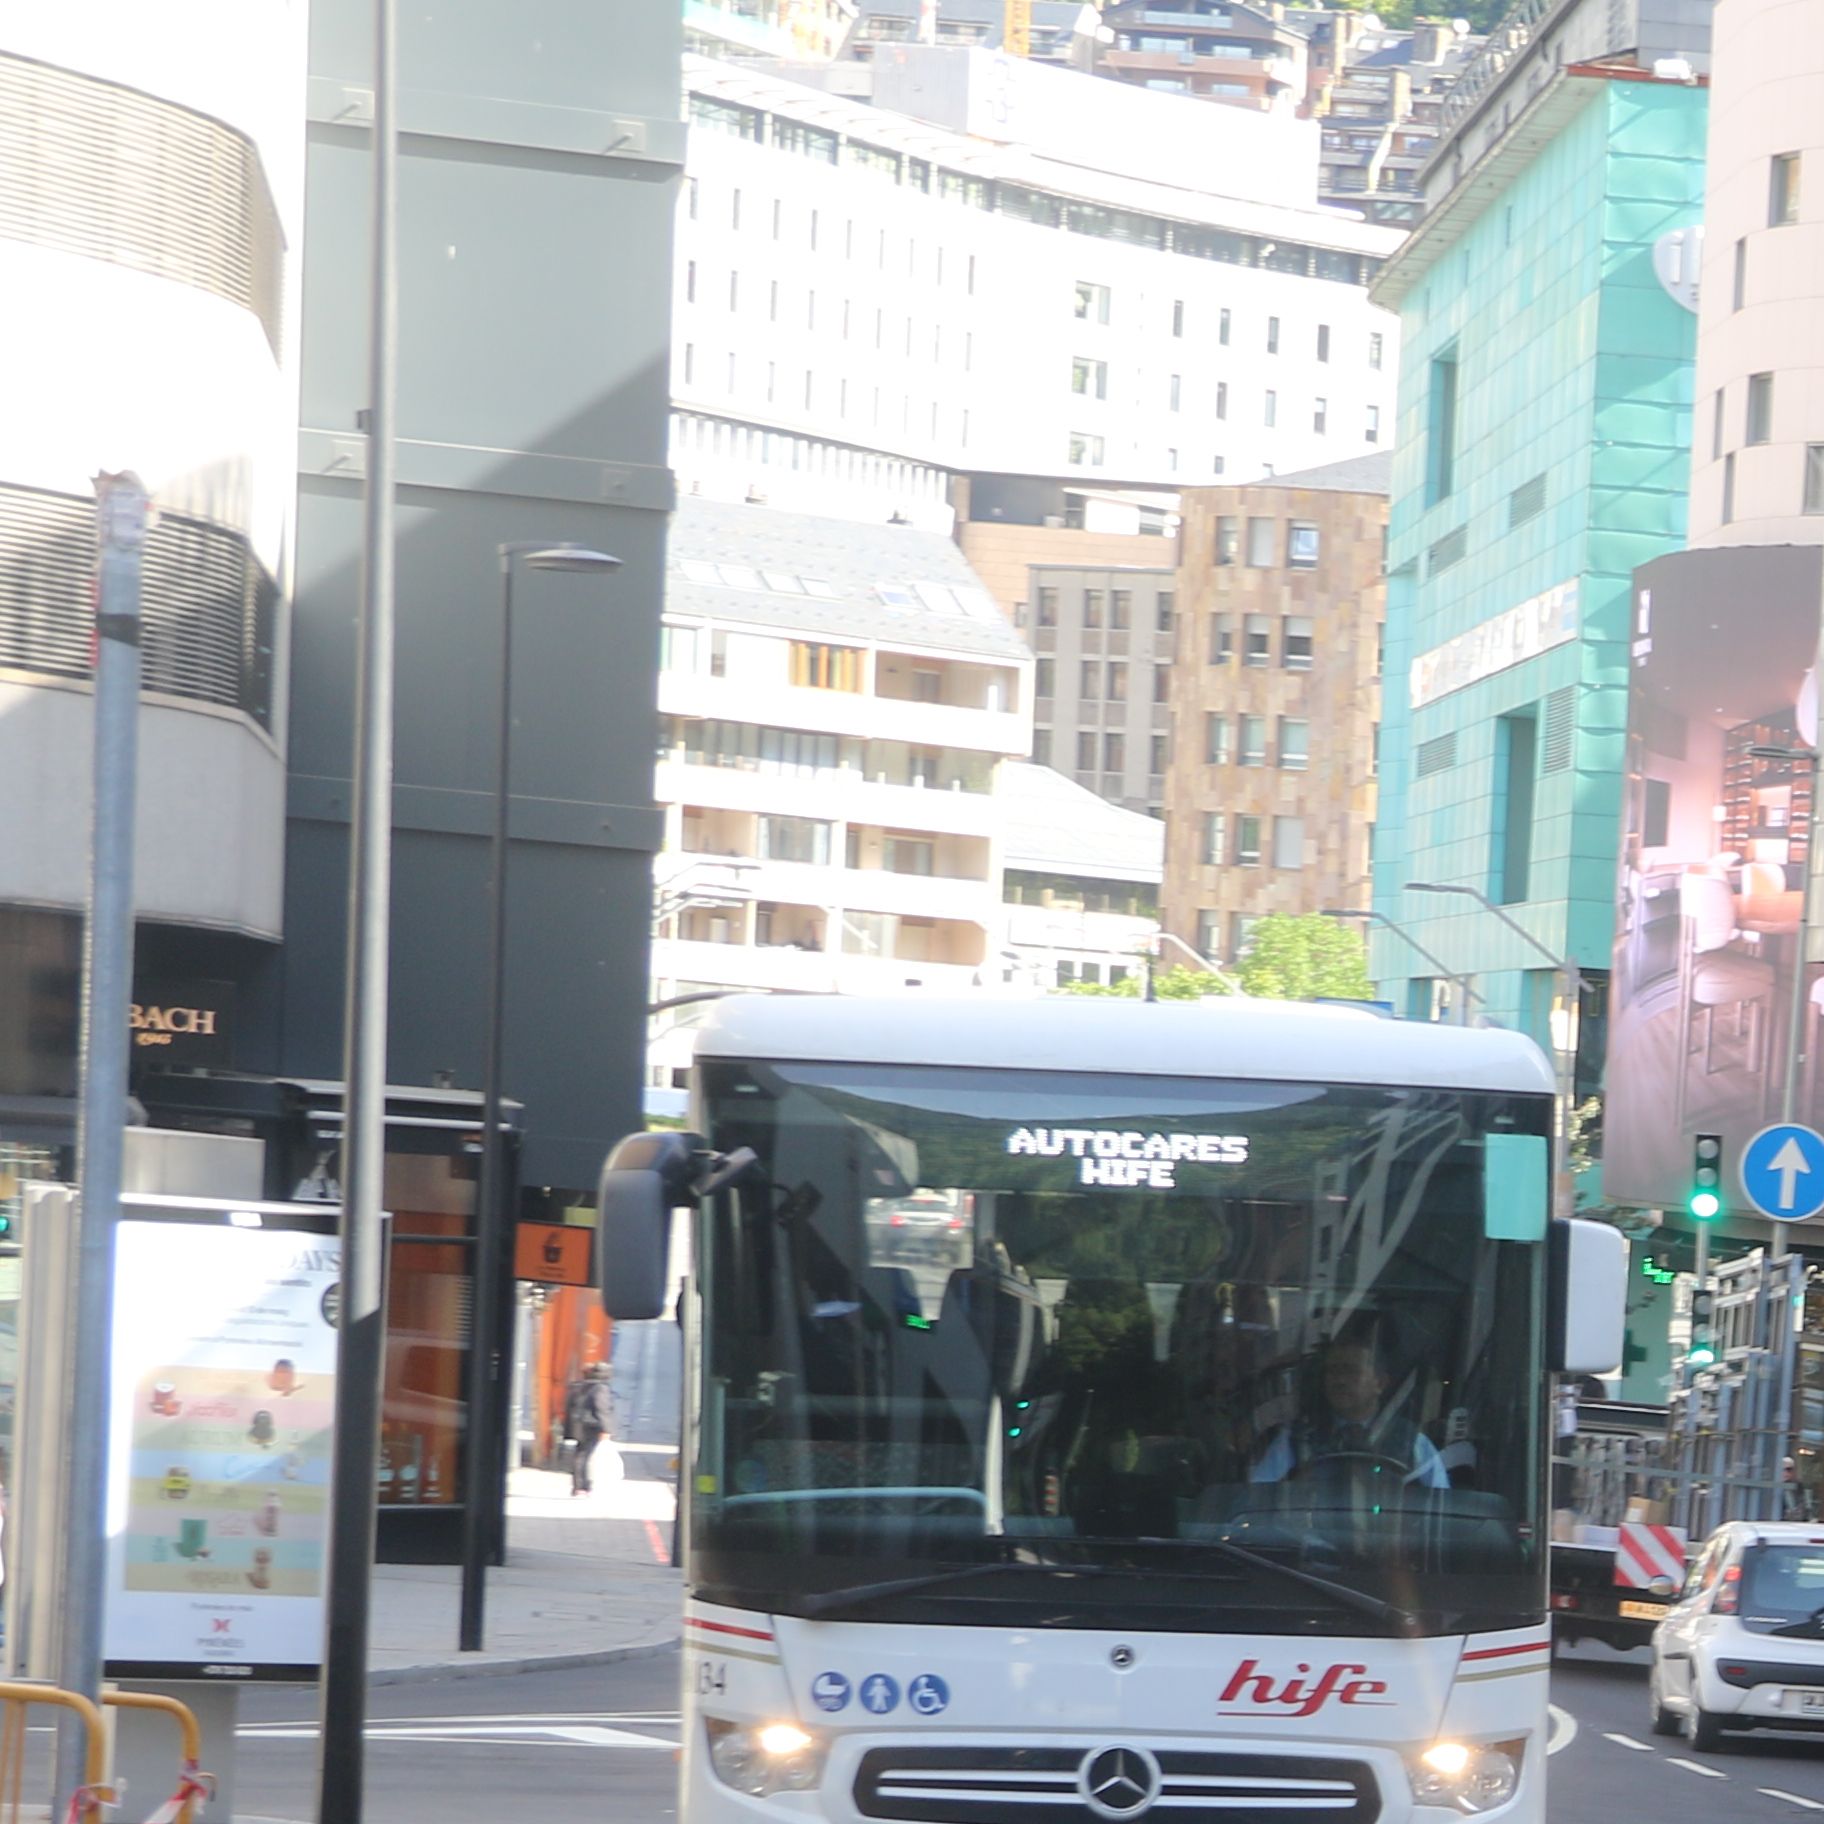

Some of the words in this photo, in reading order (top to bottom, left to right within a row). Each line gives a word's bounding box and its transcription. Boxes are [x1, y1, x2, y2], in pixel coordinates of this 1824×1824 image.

[128, 1003, 216, 1034] BACH
[1007, 1127, 1250, 1163] AUTOCARES
[1079, 1157, 1176, 1188] HIFE
[1217, 1659, 1399, 1718] hife
